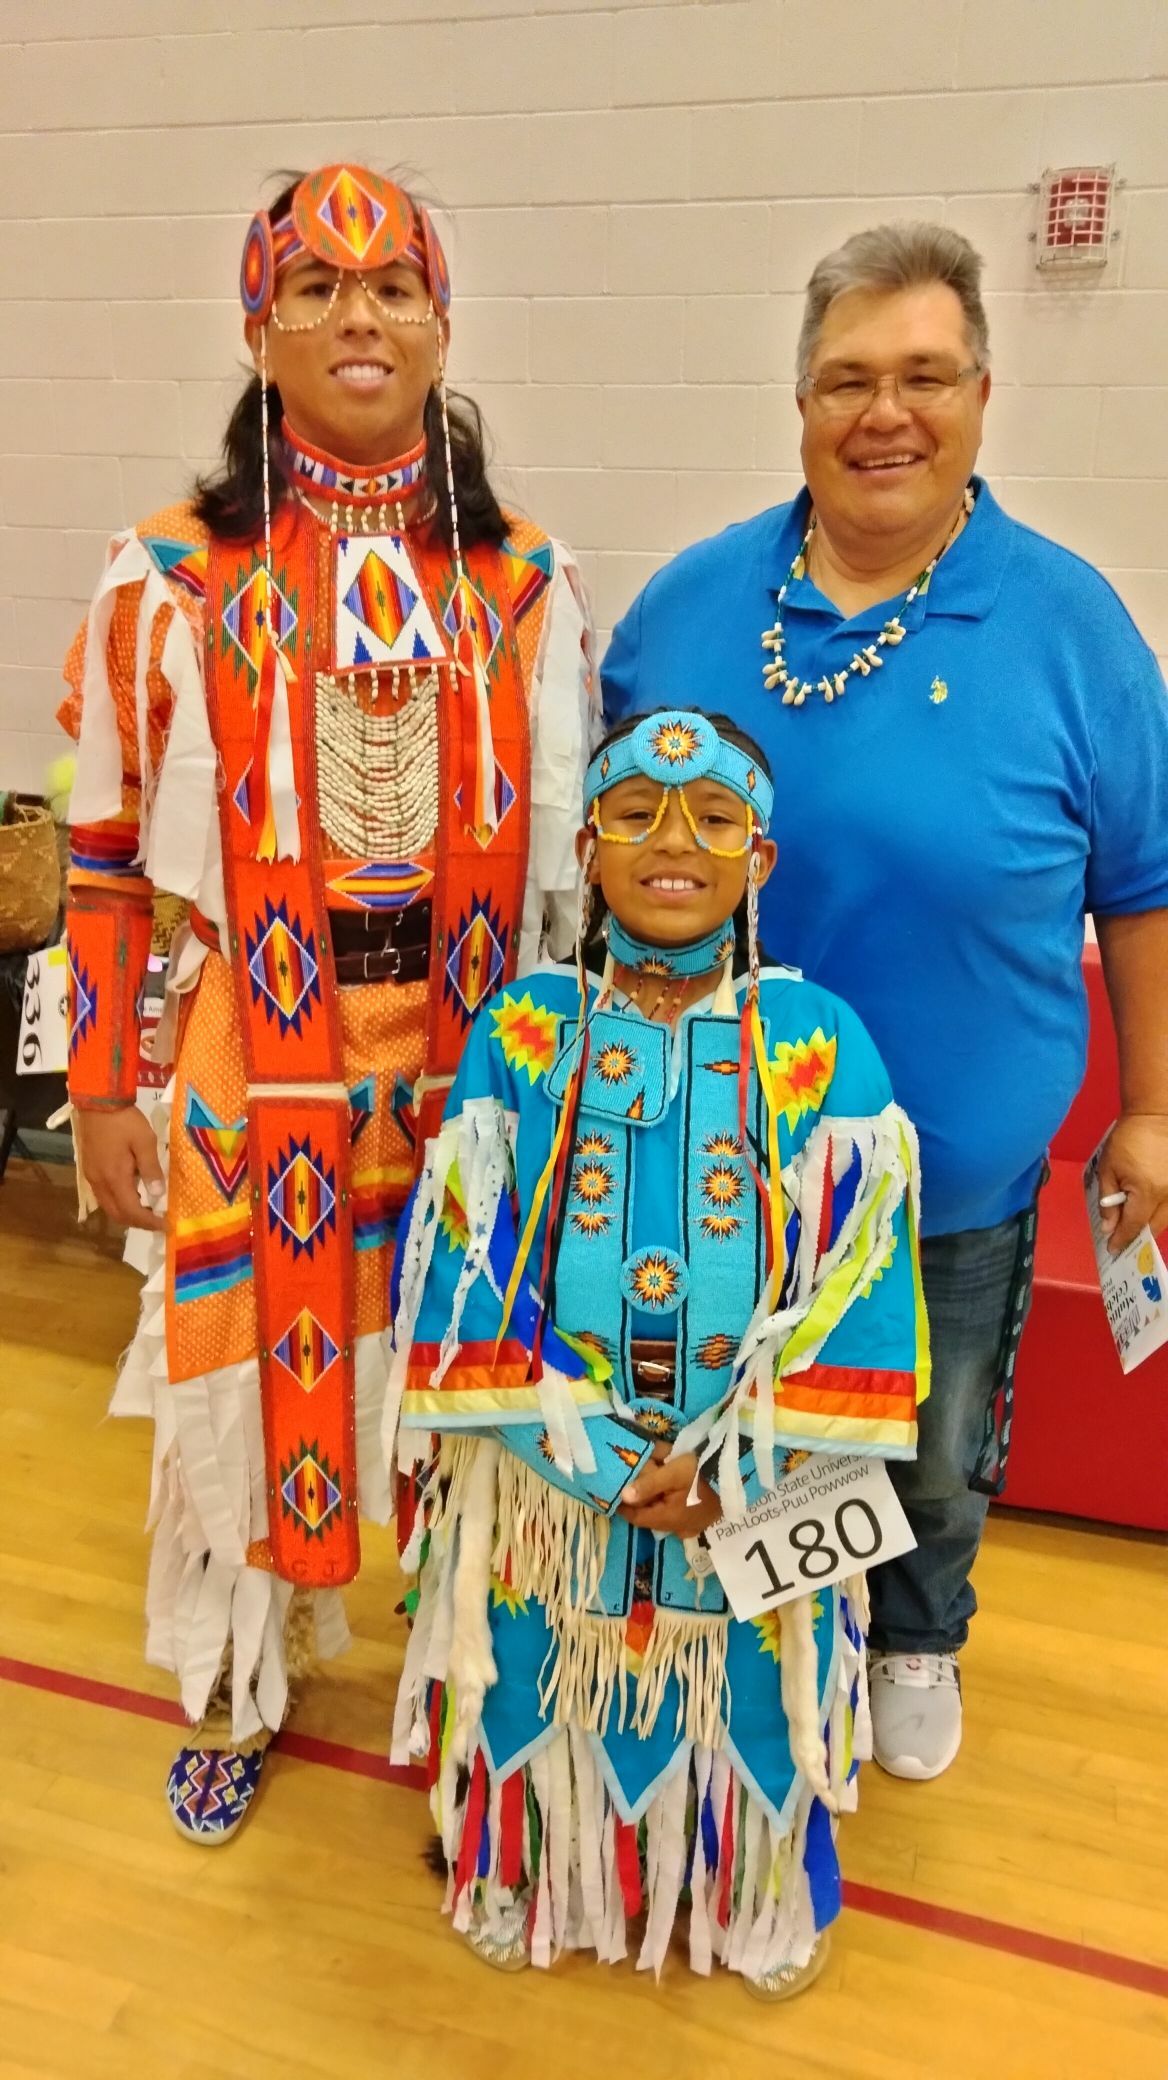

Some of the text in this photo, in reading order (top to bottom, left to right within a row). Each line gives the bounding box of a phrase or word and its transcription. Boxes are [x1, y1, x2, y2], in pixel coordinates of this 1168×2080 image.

[23, 957, 43, 1067] 336
[715, 1493, 809, 1541] Pah-Loots-Puu
[809, 1463, 870, 1501] Powwow
[776, 1475, 811, 1498] State
[744, 1498, 883, 1600] 180
